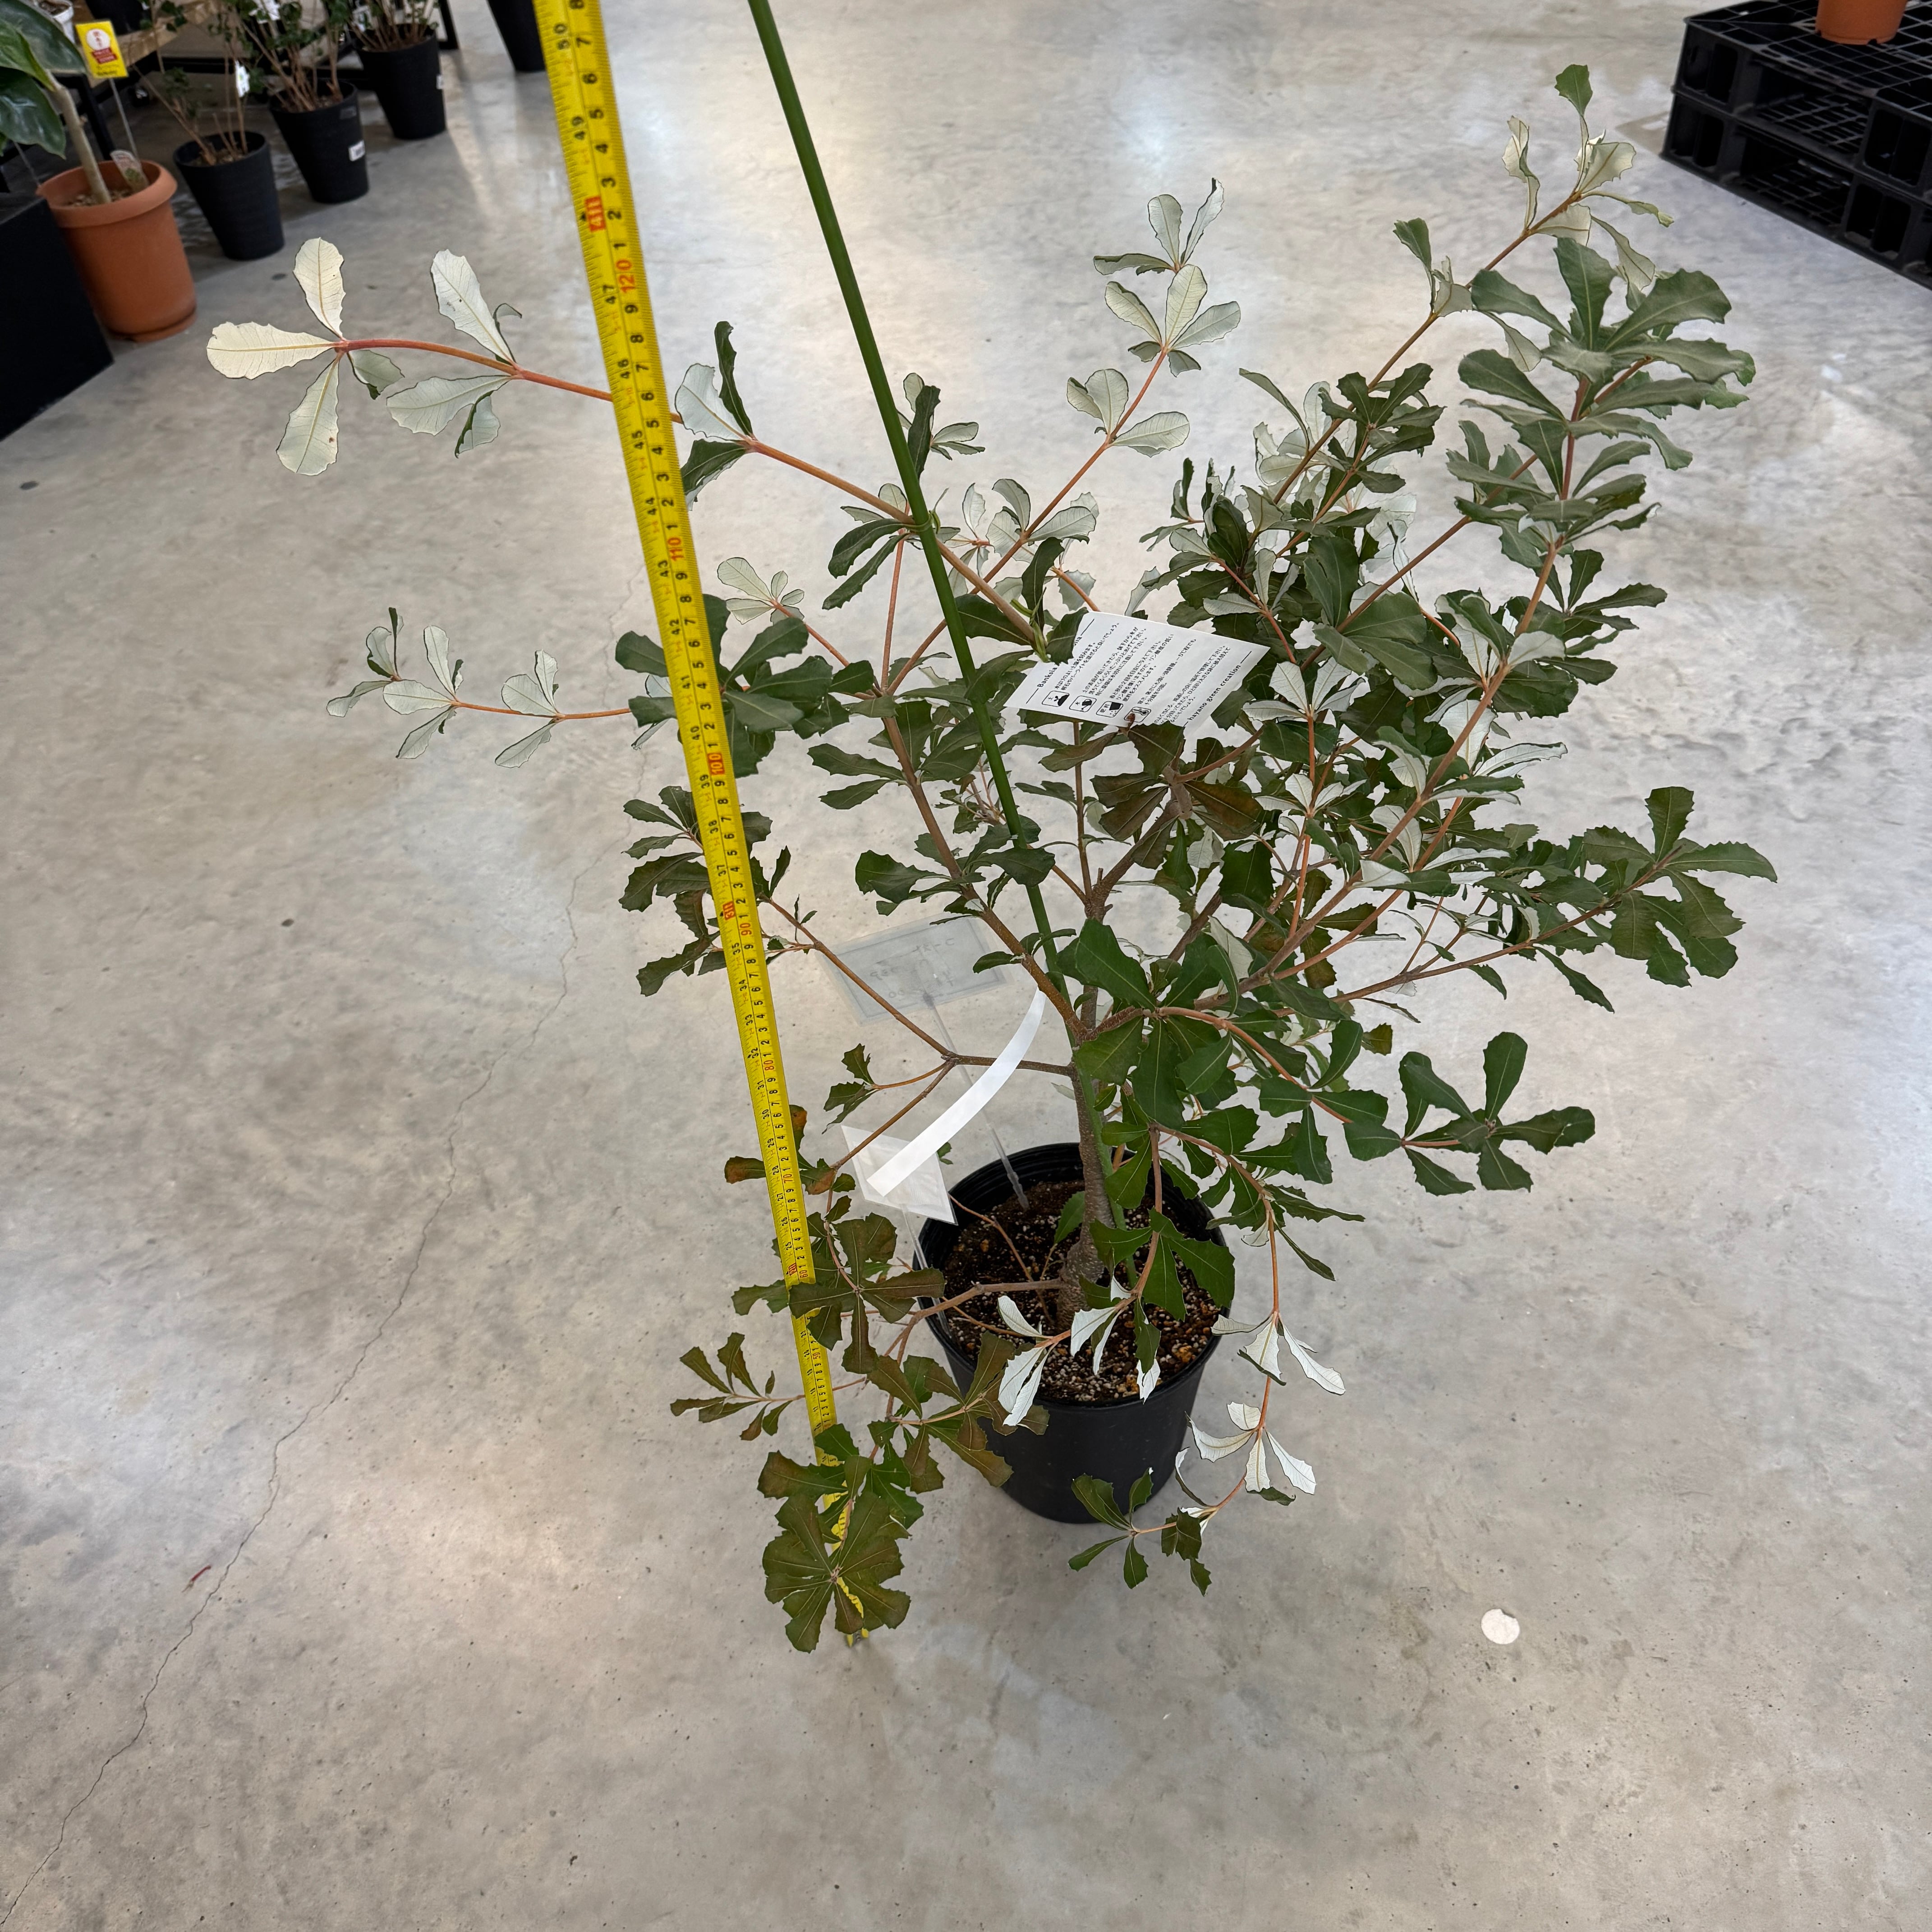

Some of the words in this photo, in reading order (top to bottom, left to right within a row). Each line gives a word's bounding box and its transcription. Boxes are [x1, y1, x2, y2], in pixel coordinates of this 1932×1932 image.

[554, 24, 570, 50] 50
[576, 37, 591, 48] 7
[582, 73, 598, 84] 6
[590, 108, 604, 120] 5
[572, 115, 585, 140] 49
[595, 143, 608, 154] 4
[601, 177, 616, 188] 3
[607, 210, 621, 221] 2
[616, 259, 635, 293] 120
[603, 284, 616, 304] 47
[625, 304, 638, 314] 9
[630, 335, 644, 343] 8
[618, 359, 630, 379] 46
[636, 363, 649, 372] 7
[641, 392, 654, 401] 6
[646, 419, 659, 428] 5
[632, 430, 644, 450] 45
[652, 446, 664, 455] 4
[656, 474, 670, 482] 3
[645, 497, 657, 515] 44
[667, 537, 684, 561] 110
[657, 560, 669, 577] 43
[669, 619, 680, 635] 42
[681, 675, 690, 689] 41
[1037, 667, 1057, 687] Banksia
[1187, 702, 1208, 720] hayano
[1204, 687, 1222, 701] green
[1218, 664, 1242, 686] creation
[690, 726, 701, 741] 40
[709, 754, 724, 774] 100
[699, 774, 711, 789] 39
[708, 820, 719, 834] 38
[717, 865, 726, 877] 37
[740, 922, 752, 936] 90
[731, 943, 741, 955] 35
[739, 979, 747, 991] 34
[745, 1014, 753, 1026] 33
[751, 1047, 759, 1058] 32
[763, 1060, 774, 1071] 80
[757, 1080, 764, 1090] 31
[762, 1109, 769, 1119] 30
[767, 1138, 775, 1148] 29
[772, 1165, 779, 1175] 28
[783, 1174, 793, 1183] 70
[777, 1193, 784, 1201] 27
[781, 1217, 788, 1226] 26
[785, 1242, 792, 1251] 25
[800, 1270, 809, 1278] 60
